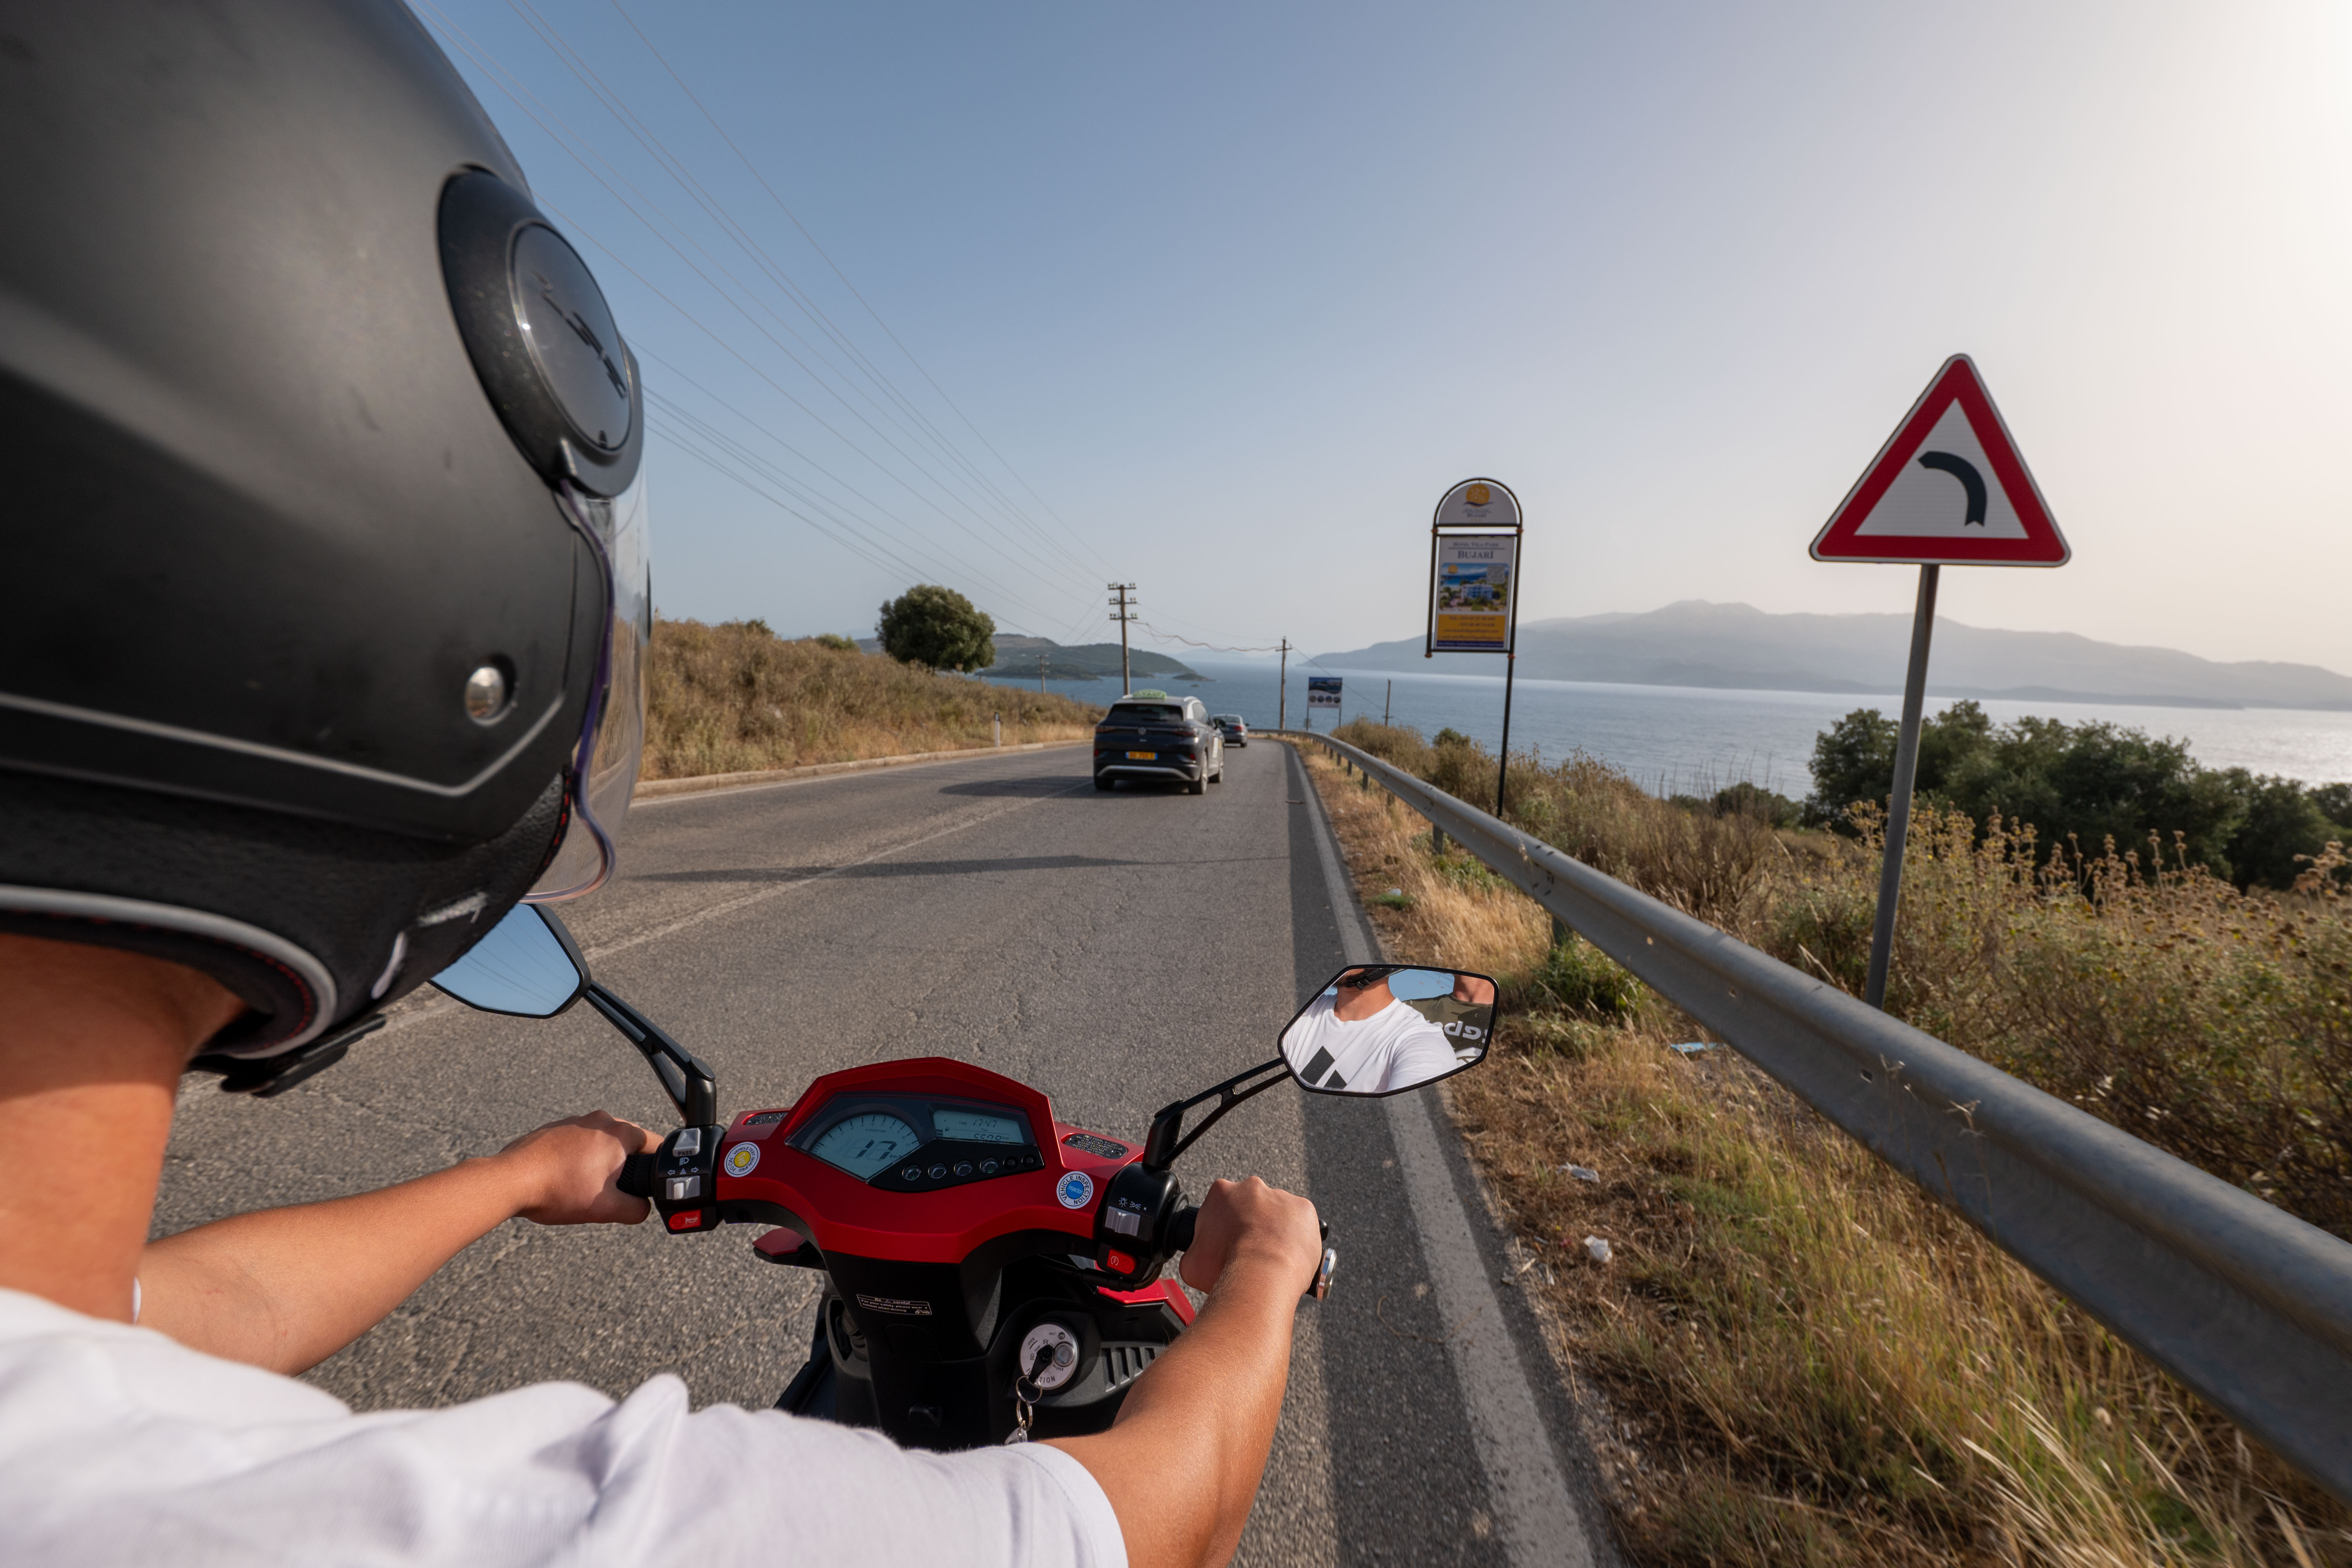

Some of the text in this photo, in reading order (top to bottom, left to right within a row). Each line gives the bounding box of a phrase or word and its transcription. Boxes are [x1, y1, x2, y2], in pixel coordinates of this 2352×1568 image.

[1457, 550, 1494, 559] BUJARI
[973, 1119, 996, 1127] 17:47
[733, 1147, 749, 1155] VEHICLE
[855, 1140, 897, 1161] 17
[739, 1157, 755, 1172] QUALIFIED
[1060, 1175, 1089, 1205] VEHICLE INSPECTION
